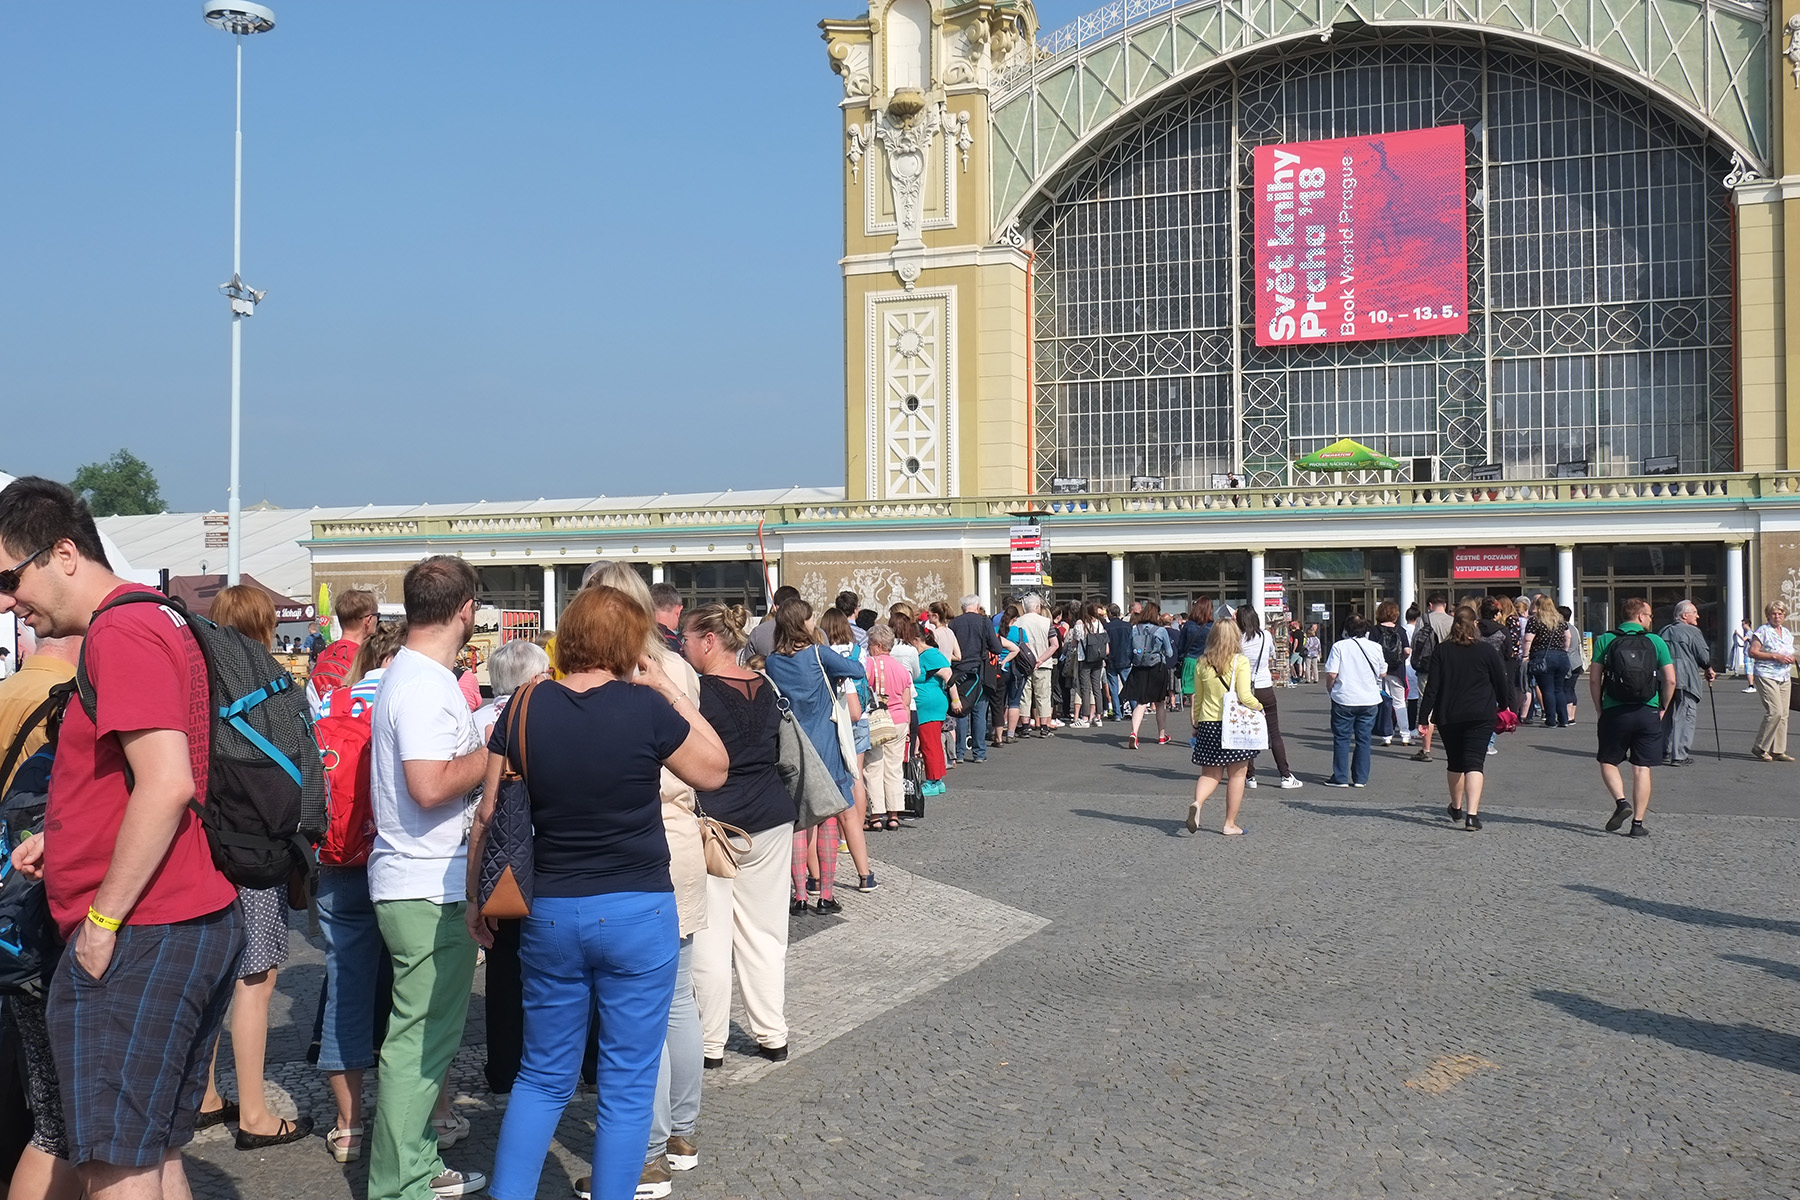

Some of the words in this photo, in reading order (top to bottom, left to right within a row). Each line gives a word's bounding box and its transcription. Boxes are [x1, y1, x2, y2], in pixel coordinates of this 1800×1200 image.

[1266, 149, 1300, 246] knihy
[1338, 155, 1357, 224] Prague
[1299, 225, 1327, 338] Praha
[1338, 228, 1355, 284] World
[1266, 253, 1296, 341] Svět
[1340, 288, 1355, 336] Book
[1368, 309, 1394, 323] 10.
[1413, 307, 1439, 321] 13.
[1442, 305, 1459, 319] 5.
